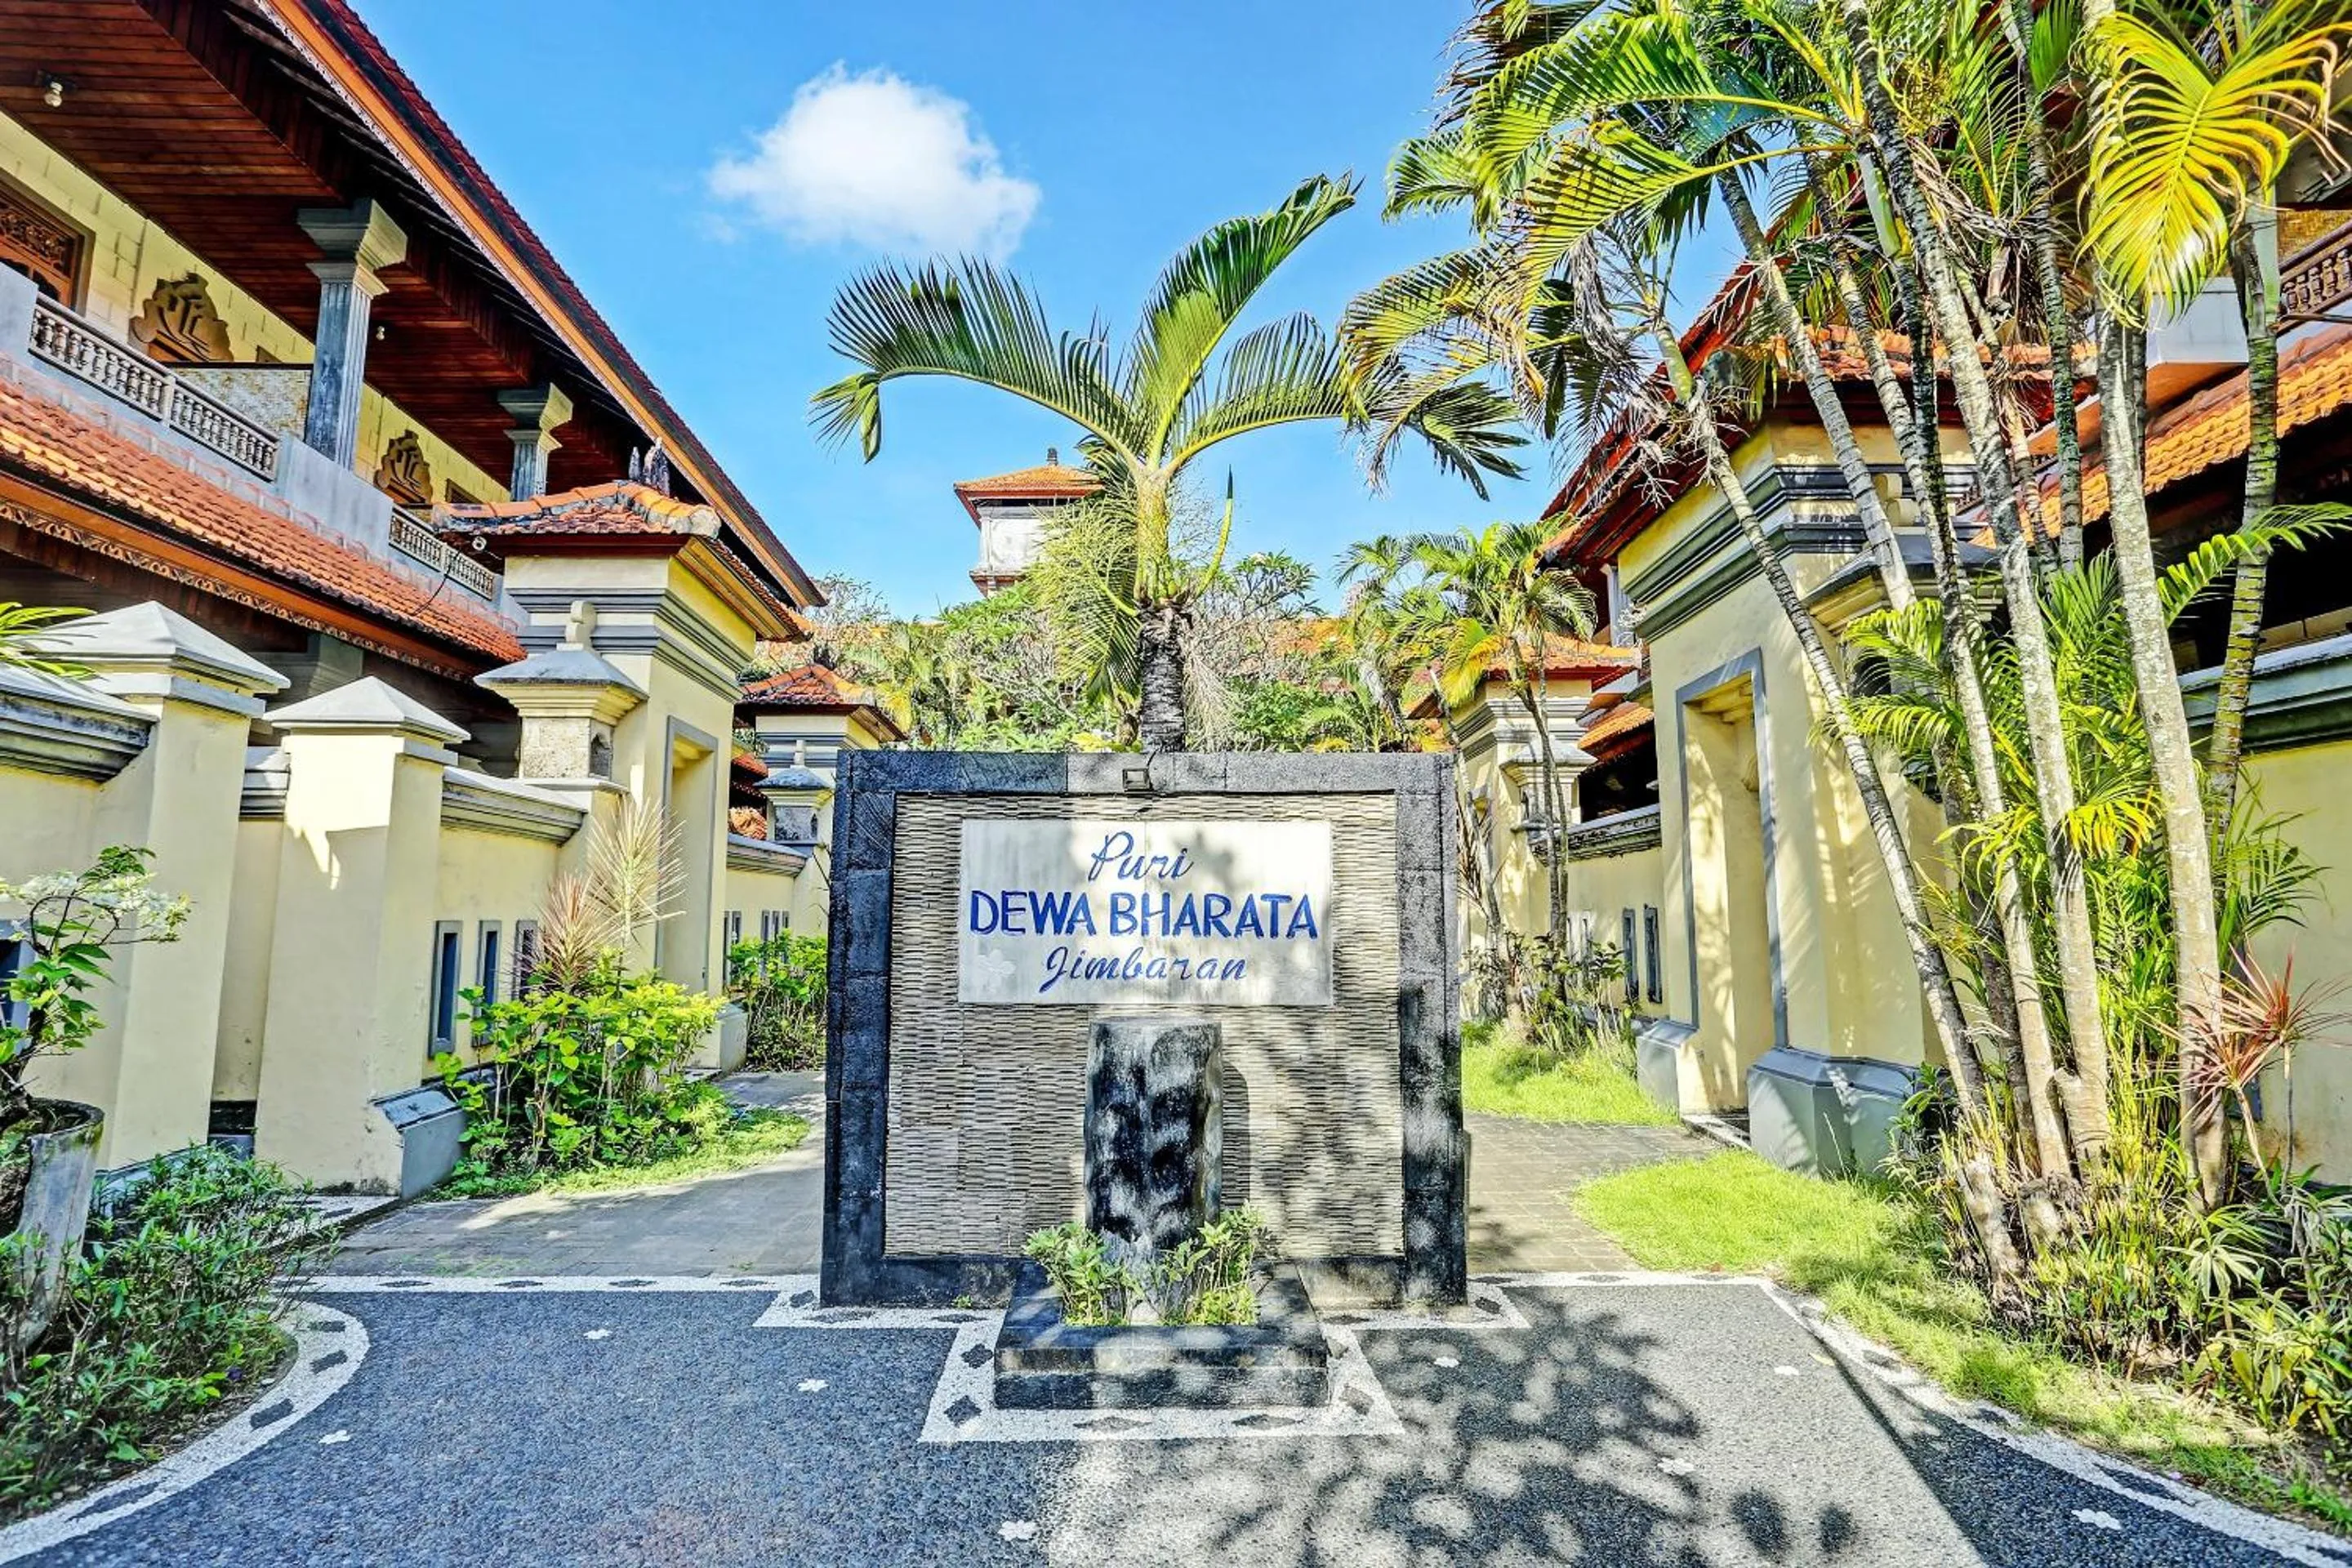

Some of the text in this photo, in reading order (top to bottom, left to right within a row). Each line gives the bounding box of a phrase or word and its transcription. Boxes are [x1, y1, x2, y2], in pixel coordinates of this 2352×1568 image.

[1088, 831, 1194, 882] Puri
[969, 890, 1319, 939] DEWA BHARATA
[1039, 947, 1248, 994] Jimbaran
